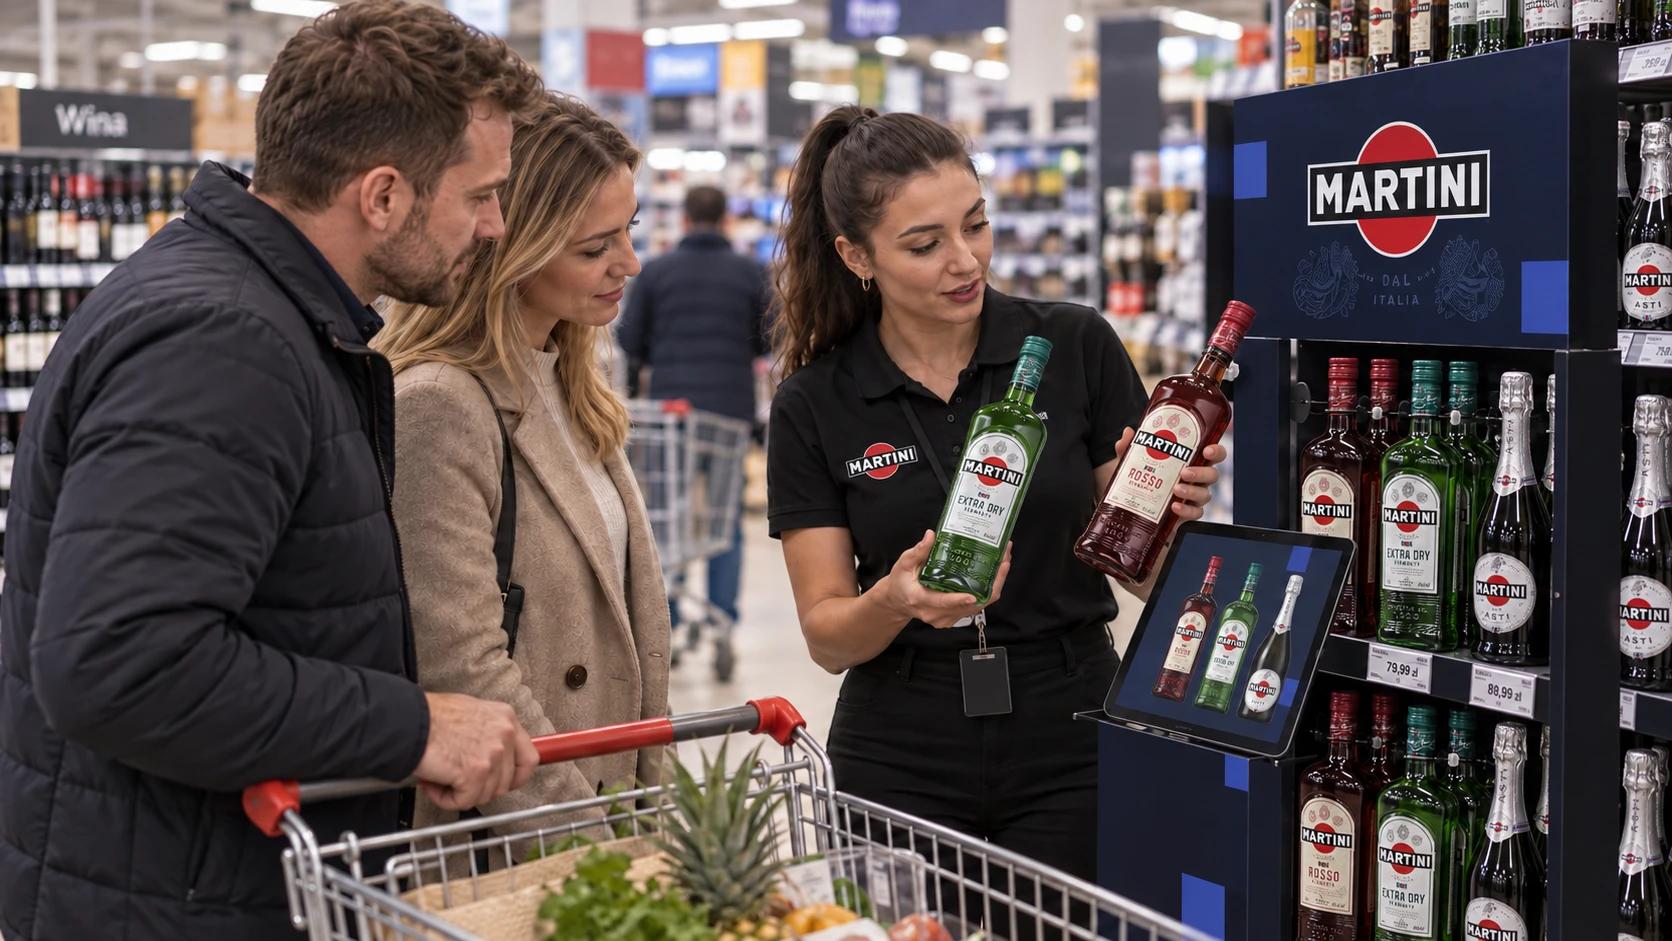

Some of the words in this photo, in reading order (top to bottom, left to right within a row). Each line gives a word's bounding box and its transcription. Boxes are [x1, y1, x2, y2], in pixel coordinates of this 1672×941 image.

[56, 104, 127, 136] Wina
[1316, 162, 1480, 215] MARTINI
[1382, 274, 1410, 287] DAL
[1625, 274, 1671, 287] MARTIN
[1373, 294, 1419, 306] ITALIA
[1635, 301, 1662, 309] ASTI
[1136, 432, 1190, 461] MARTINI
[849, 448, 915, 475] MARTINI
[964, 460, 1021, 486] MARTINI
[1128, 468, 1163, 490] ROSSO
[958, 495, 985, 511] EXTRA
[987, 503, 1005, 517] DRY
[1303, 503, 1350, 517] MARTINI
[1385, 509, 1435, 524] MARTINI
[1387, 548, 1410, 560] EXTRA
[1414, 550, 1430, 561] DRY
[1477, 582, 1525, 597] MARTINI
[1485, 612, 1510, 620] ASTI
[1624, 635, 1652, 644] ASTI
[1387, 661, 1410, 676] 79,99
[1488, 683, 1512, 699] 88,99
[1302, 829, 1350, 847] MARTINI
[1380, 849, 1430, 867] MARTINI
[1308, 866, 1339, 882] ROSSO
[1382, 888, 1405, 902] EXTRA
[1408, 892, 1425, 904] DRY
[1468, 923, 1516, 941] MARTINI
